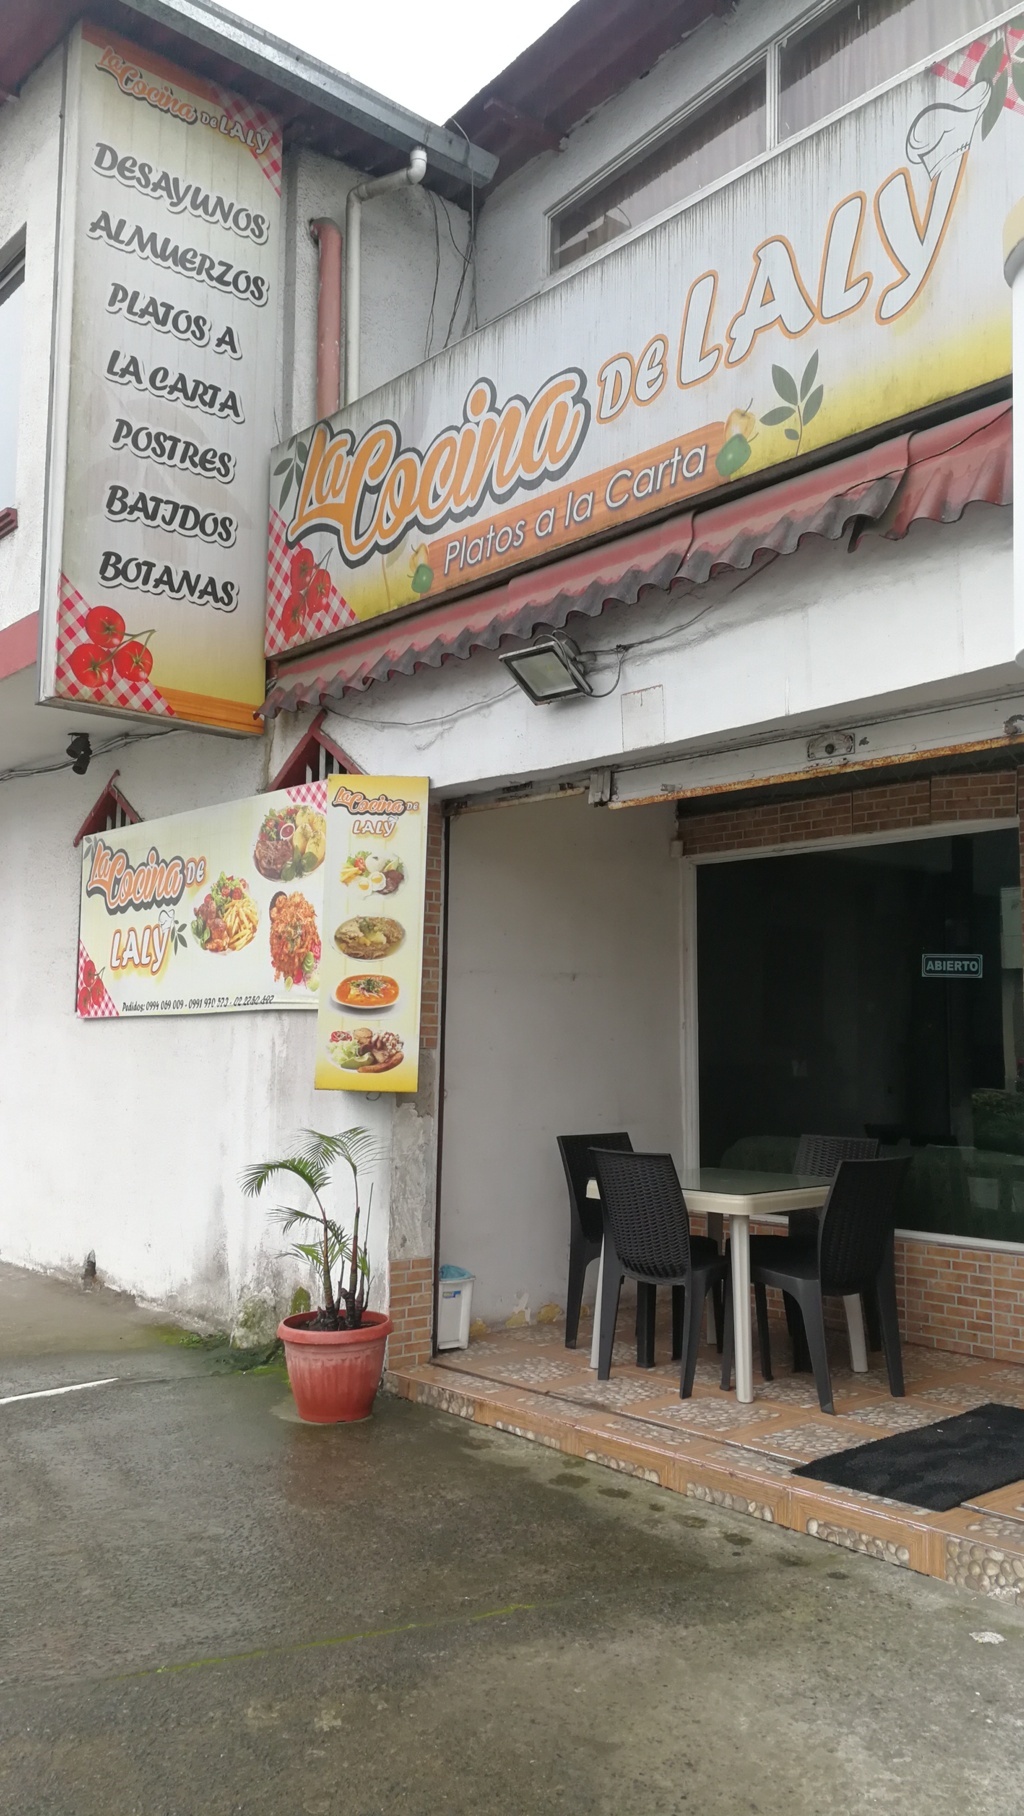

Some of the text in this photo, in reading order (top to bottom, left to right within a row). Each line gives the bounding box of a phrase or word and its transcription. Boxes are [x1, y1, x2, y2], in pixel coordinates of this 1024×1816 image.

[97, 46, 124, 71] La
[117, 64, 198, 124] Cocina
[219, 115, 271, 154] LALY
[94, 142, 267, 240] DESAYUNOS
[90, 211, 266, 301] ALMUERZOS
[108, 283, 238, 354] PLATOS A
[106, 350, 241, 418] LA CARTA
[287, 422, 353, 543] La
[341, 368, 590, 567] Cocina
[677, 149, 971, 390] LALY
[112, 418, 233, 478] POSTRES
[105, 485, 234, 542] BATIDOS
[444, 444, 708, 575] Platos a la Carta
[99, 551, 235, 606] BOTANAS
[332, 786, 352, 807] La
[347, 792, 406, 816] Cocina
[353, 820, 397, 838] LALY
[87, 839, 112, 898] La
[106, 846, 185, 916] Cocina
[110, 923, 171, 976] LALY
[926, 961, 978, 971] ABIERTO
